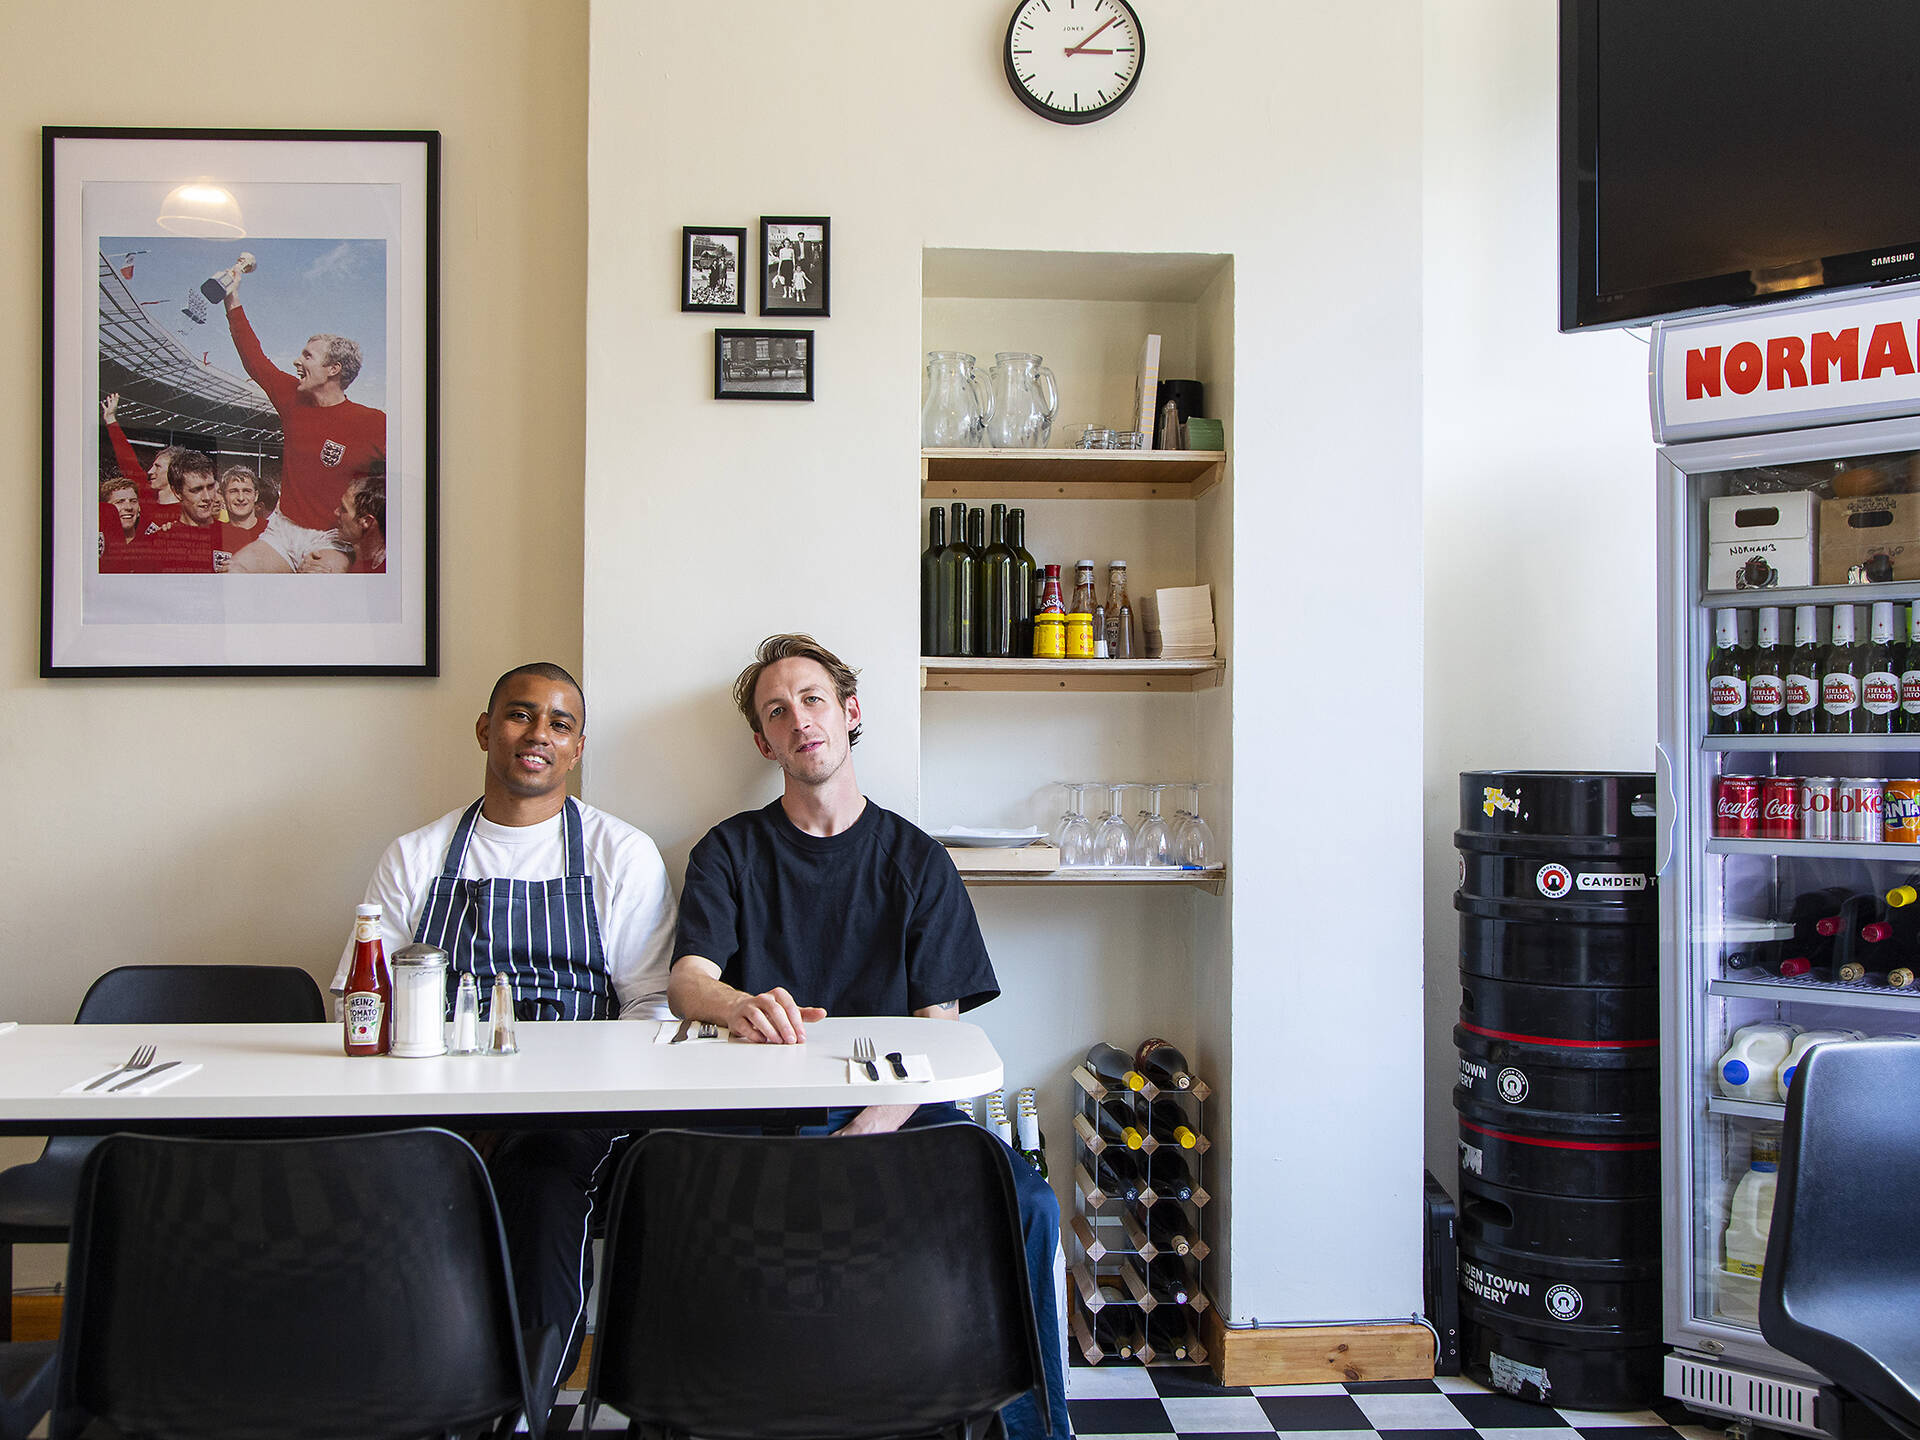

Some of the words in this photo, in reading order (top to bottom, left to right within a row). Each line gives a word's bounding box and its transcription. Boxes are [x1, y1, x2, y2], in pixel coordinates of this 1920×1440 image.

[1871, 252, 1915, 267] SAMSUNG
[1686, 318, 1920, 400] NORMA
[1840, 788, 1884, 813] oke
[1885, 799, 1920, 819] ANTA
[1582, 877, 1641, 887] CAMDEN
[351, 998, 374, 1007] HEINZ
[350, 1009, 377, 1017] TOMATO
[1462, 1059, 1487, 1080] TOWN
[1465, 1262, 1483, 1282] DEN
[1486, 1273, 1530, 1296] TOWN
[1464, 1277, 1510, 1304] REWERY
